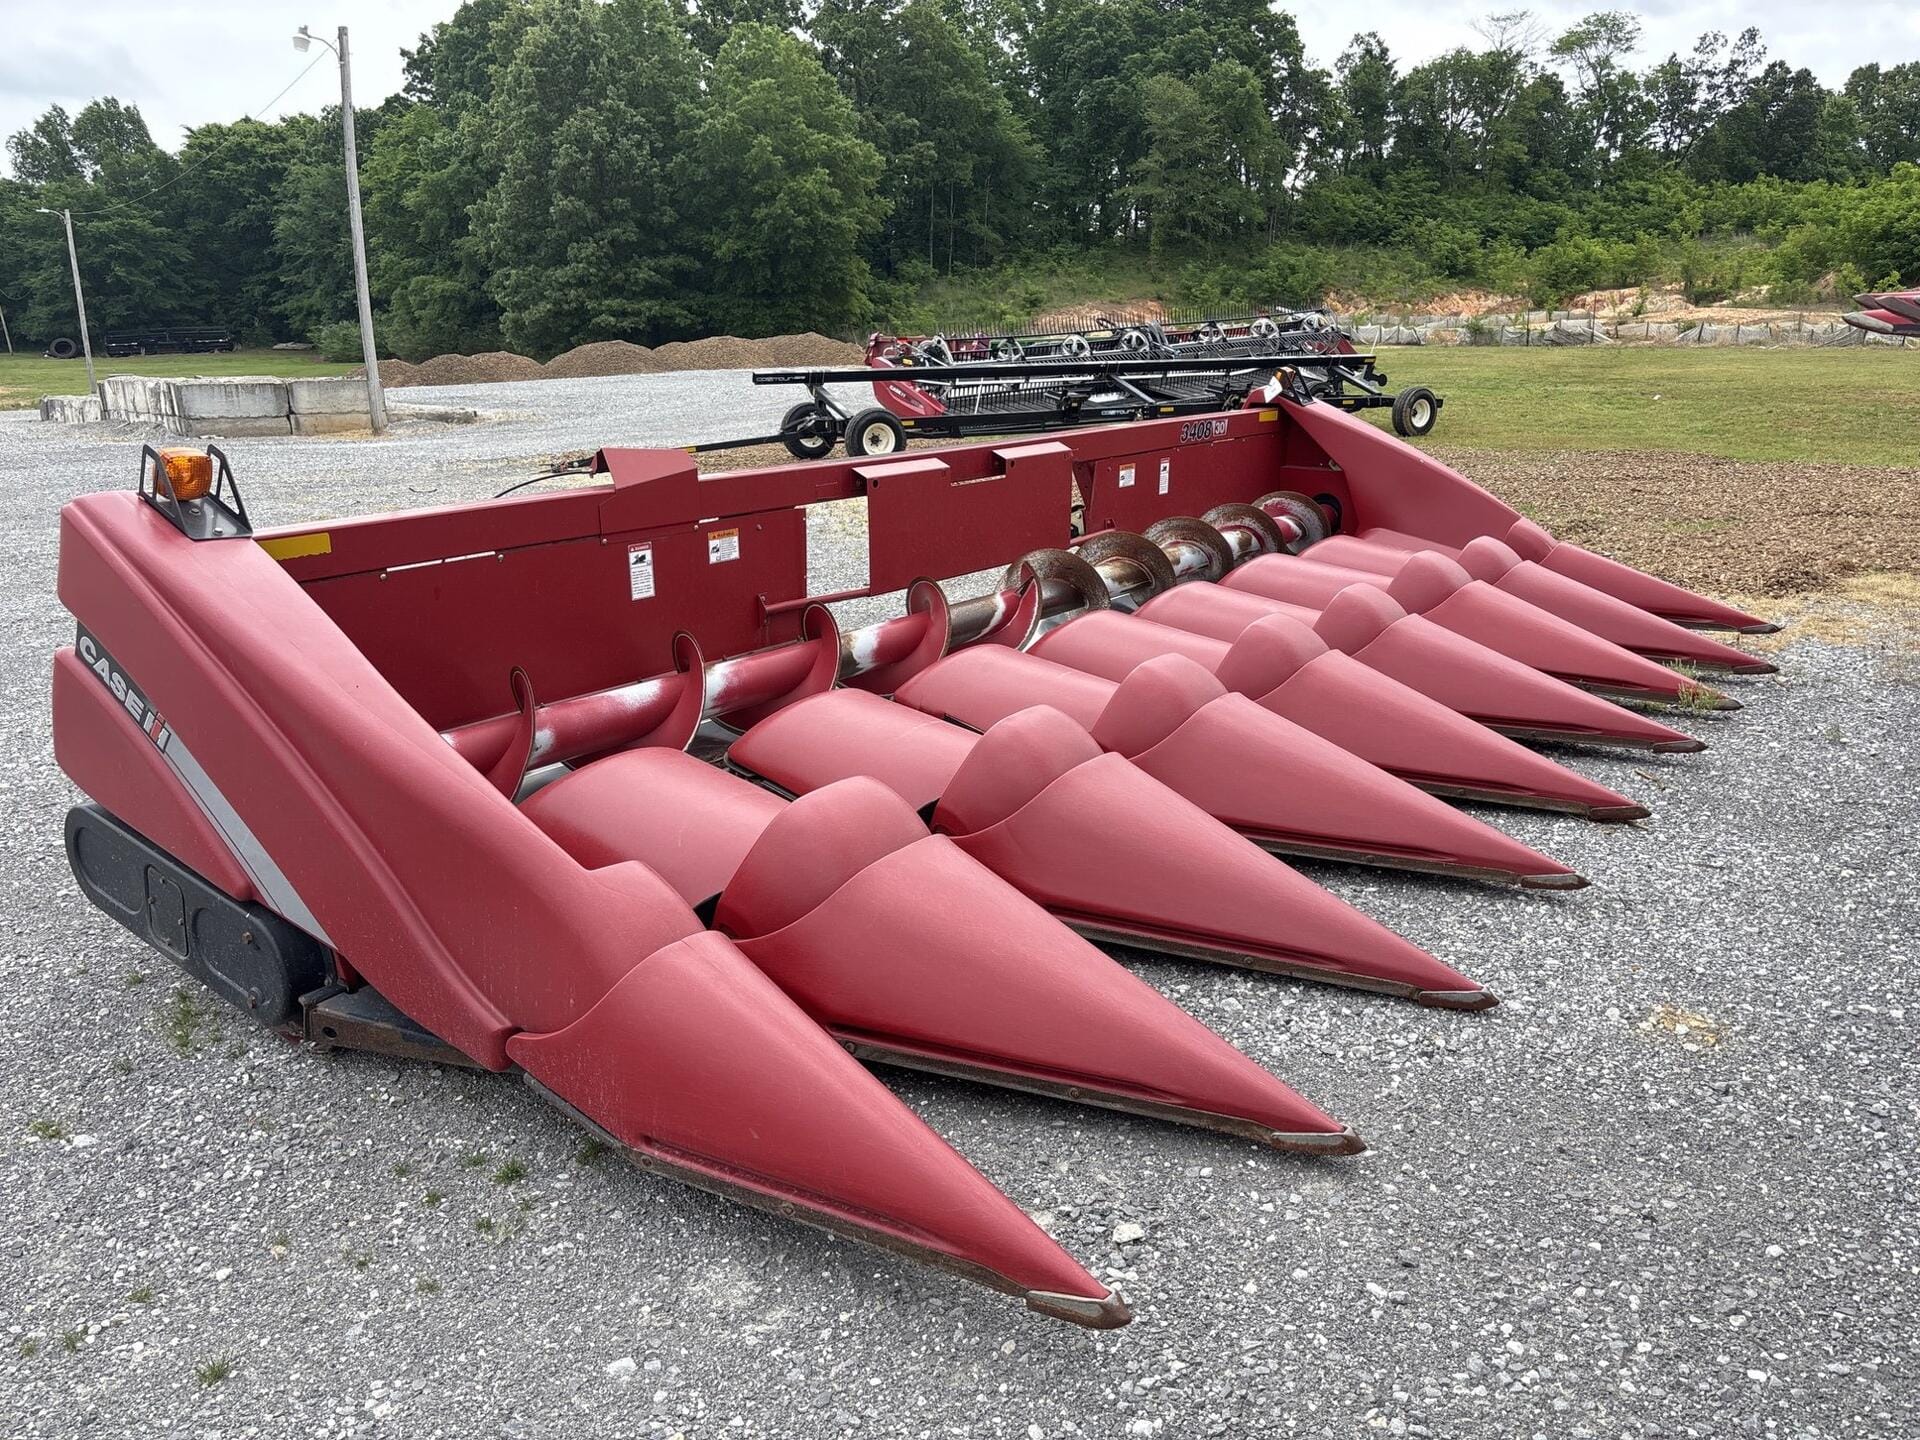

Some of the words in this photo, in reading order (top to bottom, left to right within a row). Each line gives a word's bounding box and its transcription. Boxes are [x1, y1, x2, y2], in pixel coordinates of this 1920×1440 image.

[1180, 420, 1213, 443] 3408
[1215, 421, 1225, 434] 30
[79, 636, 145, 723] CASE
